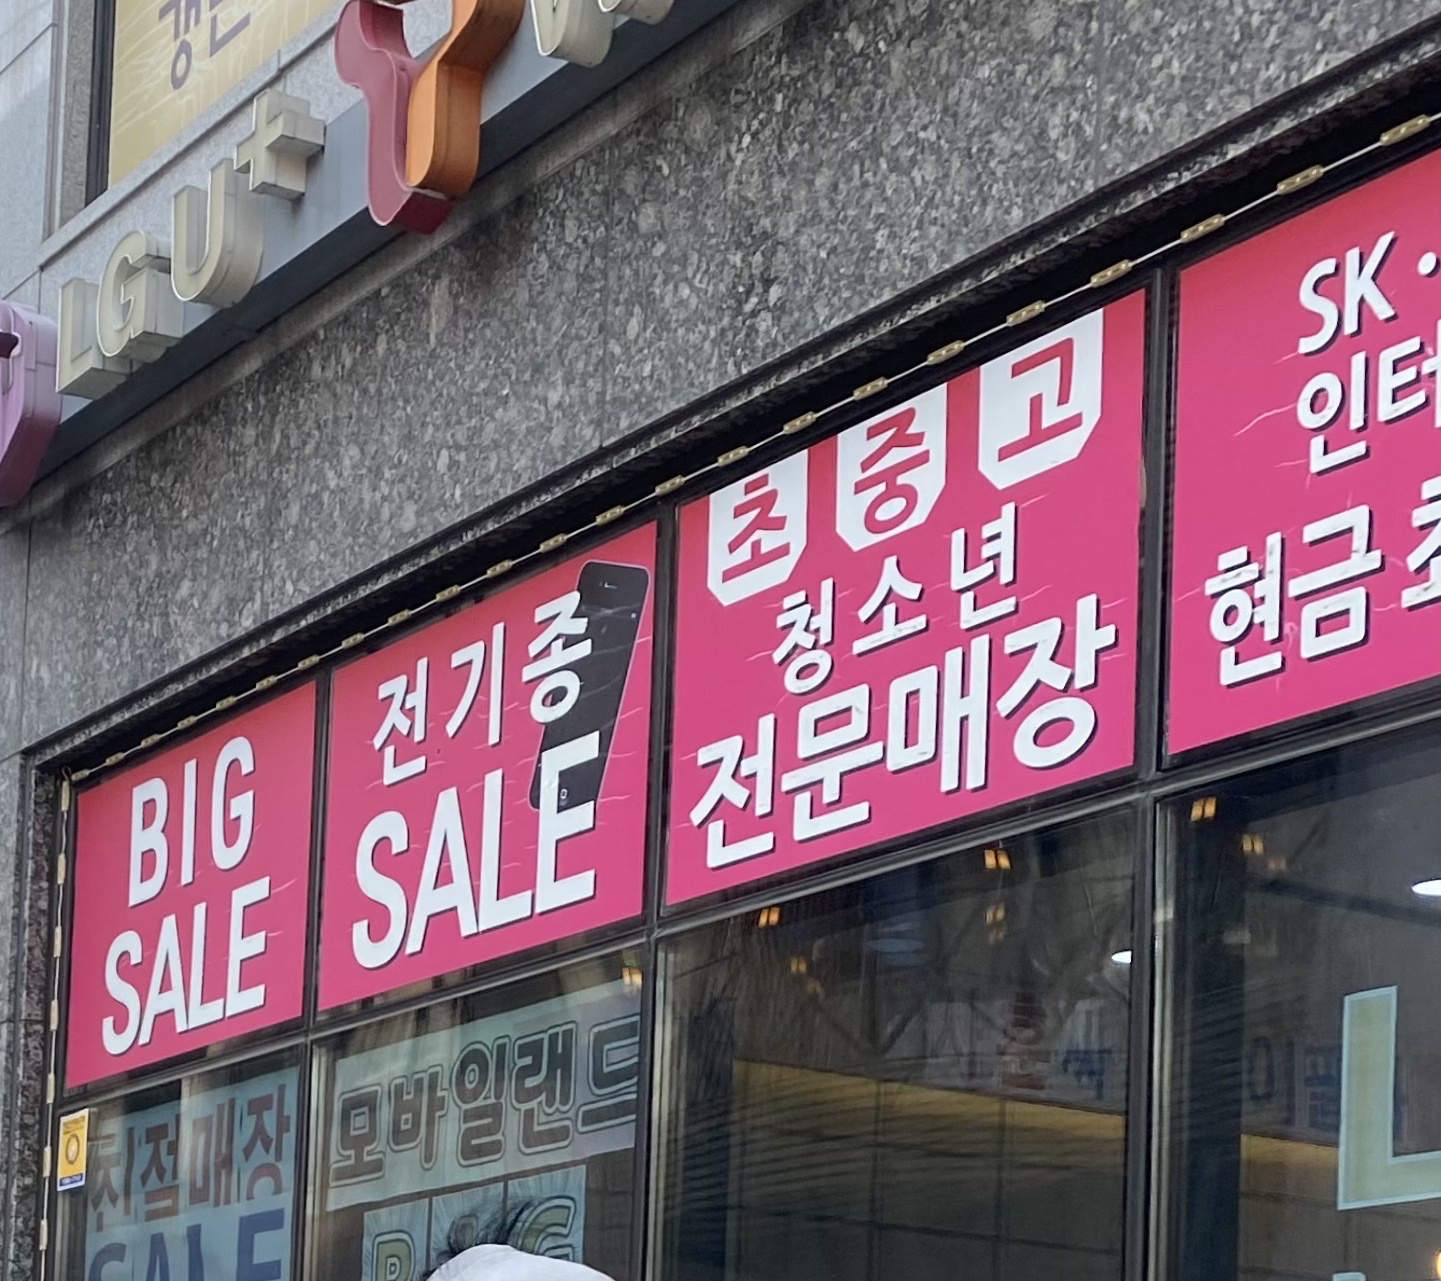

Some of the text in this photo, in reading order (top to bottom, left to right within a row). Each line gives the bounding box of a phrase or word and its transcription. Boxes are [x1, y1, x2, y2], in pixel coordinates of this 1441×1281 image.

[1297, 231, 1396, 354] SK
[373, 591, 593, 787] 전기종
[772, 500, 1018, 694] 청소년
[128, 736, 256, 908] BIG
[690, 594, 1117, 869] 전문매장
[352, 731, 602, 970] SALE
[102, 876, 271, 1056] SALE
[329, 1014, 642, 1190] 모바일랜드
